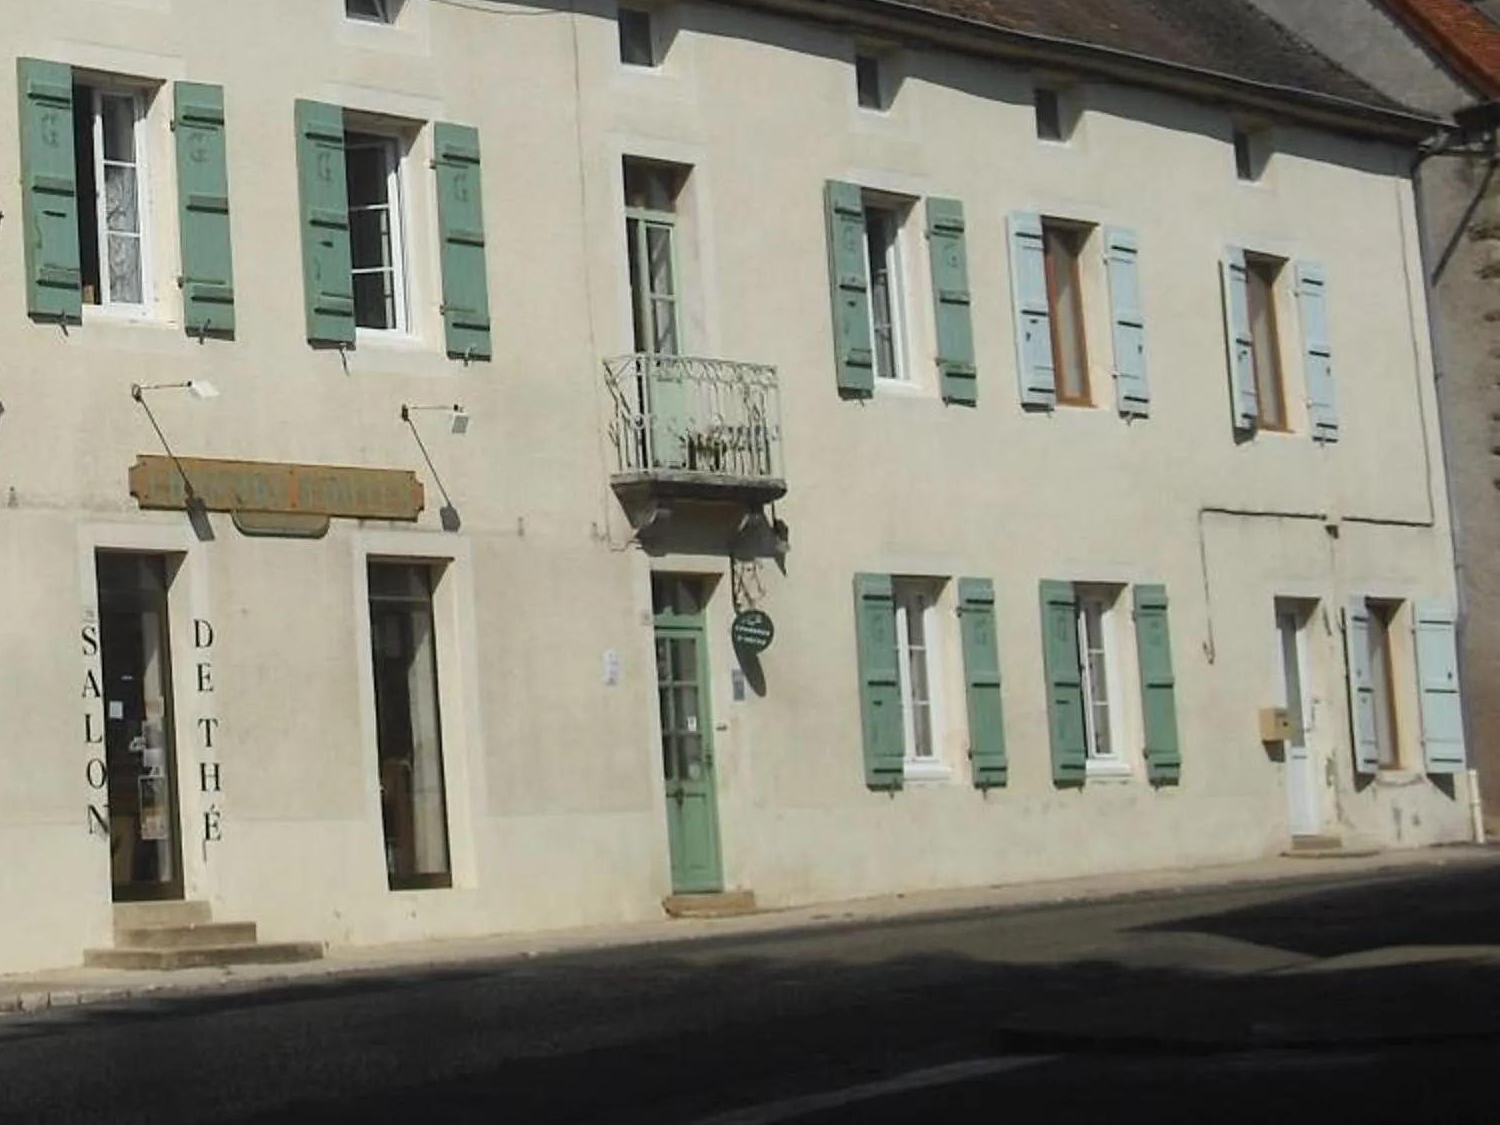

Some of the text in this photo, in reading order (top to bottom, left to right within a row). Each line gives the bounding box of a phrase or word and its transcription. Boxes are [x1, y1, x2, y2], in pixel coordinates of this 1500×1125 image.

[81, 626, 111, 836] SALON
[194, 619, 221, 841] DE THÉ
